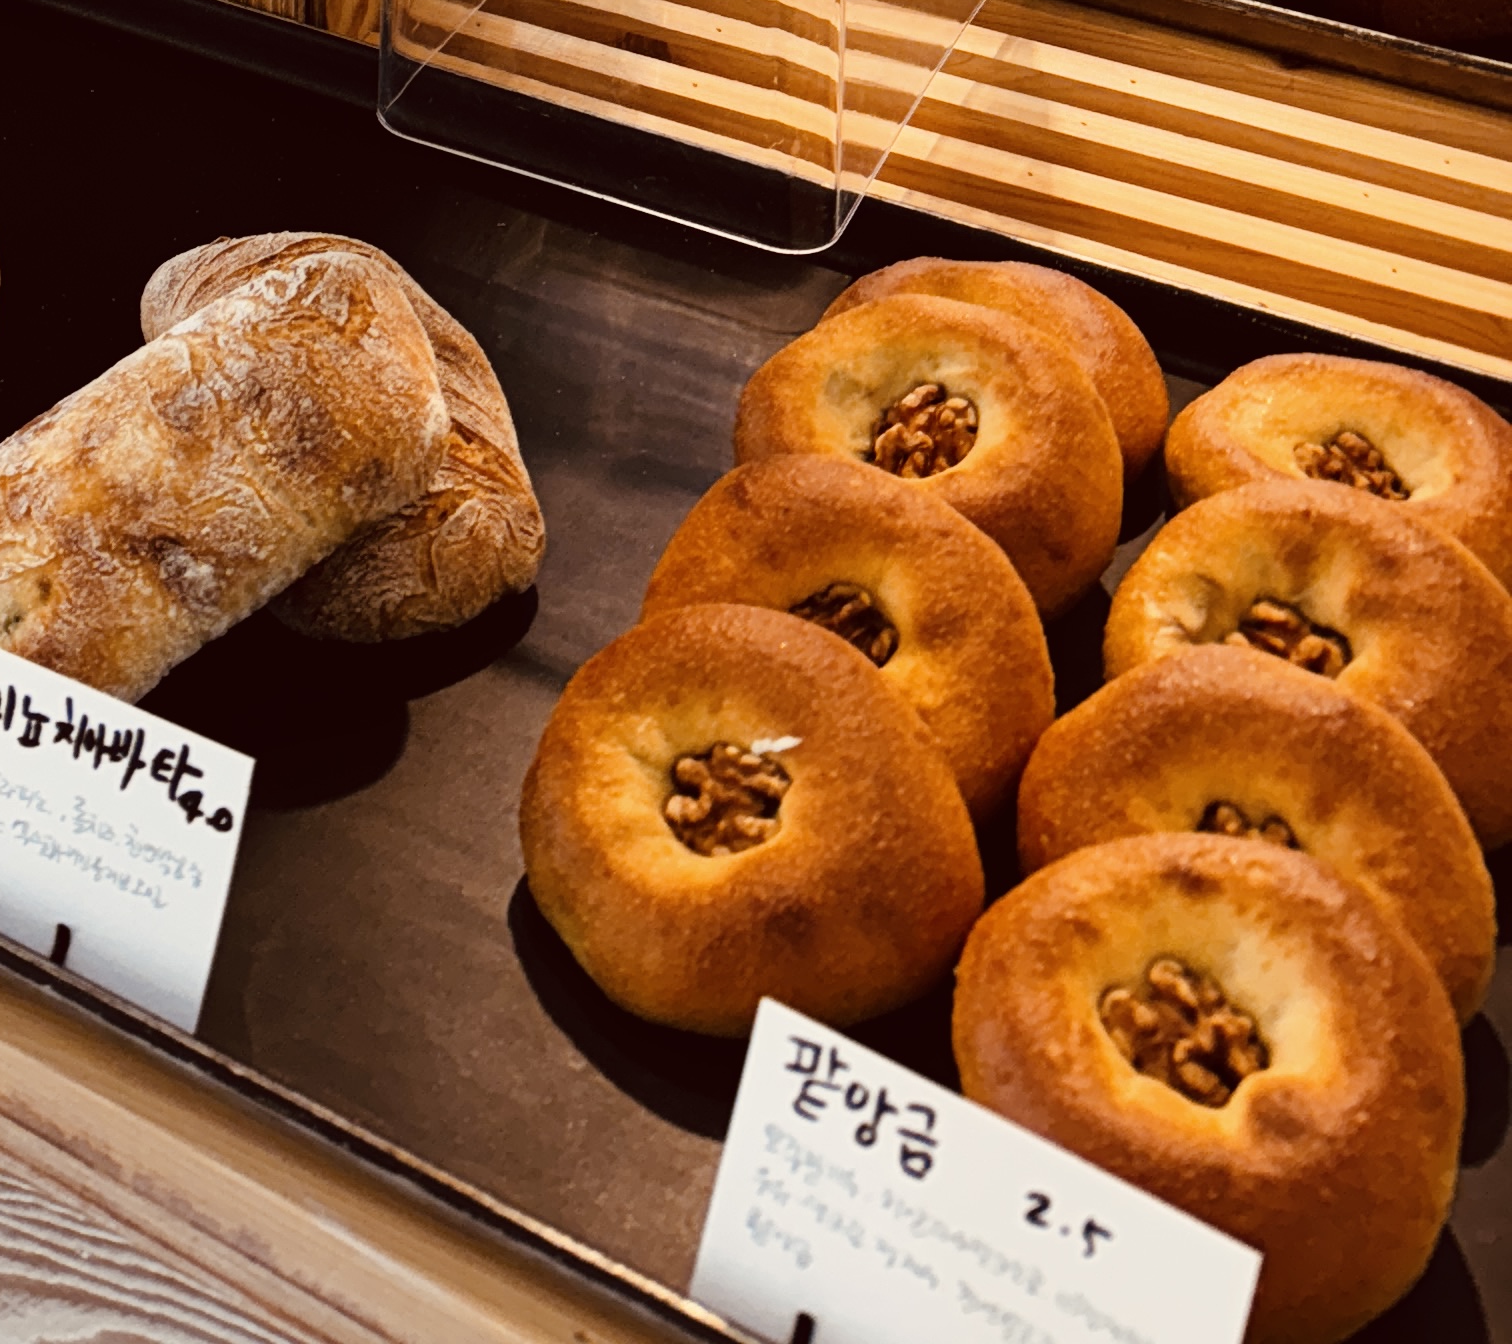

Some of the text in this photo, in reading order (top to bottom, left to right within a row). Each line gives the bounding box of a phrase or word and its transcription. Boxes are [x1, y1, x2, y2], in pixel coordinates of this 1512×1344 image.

[177, 789, 234, 833] 4.0
[783, 1034, 939, 1182] 팥앙금
[1023, 1190, 1114, 1259] 2.5
